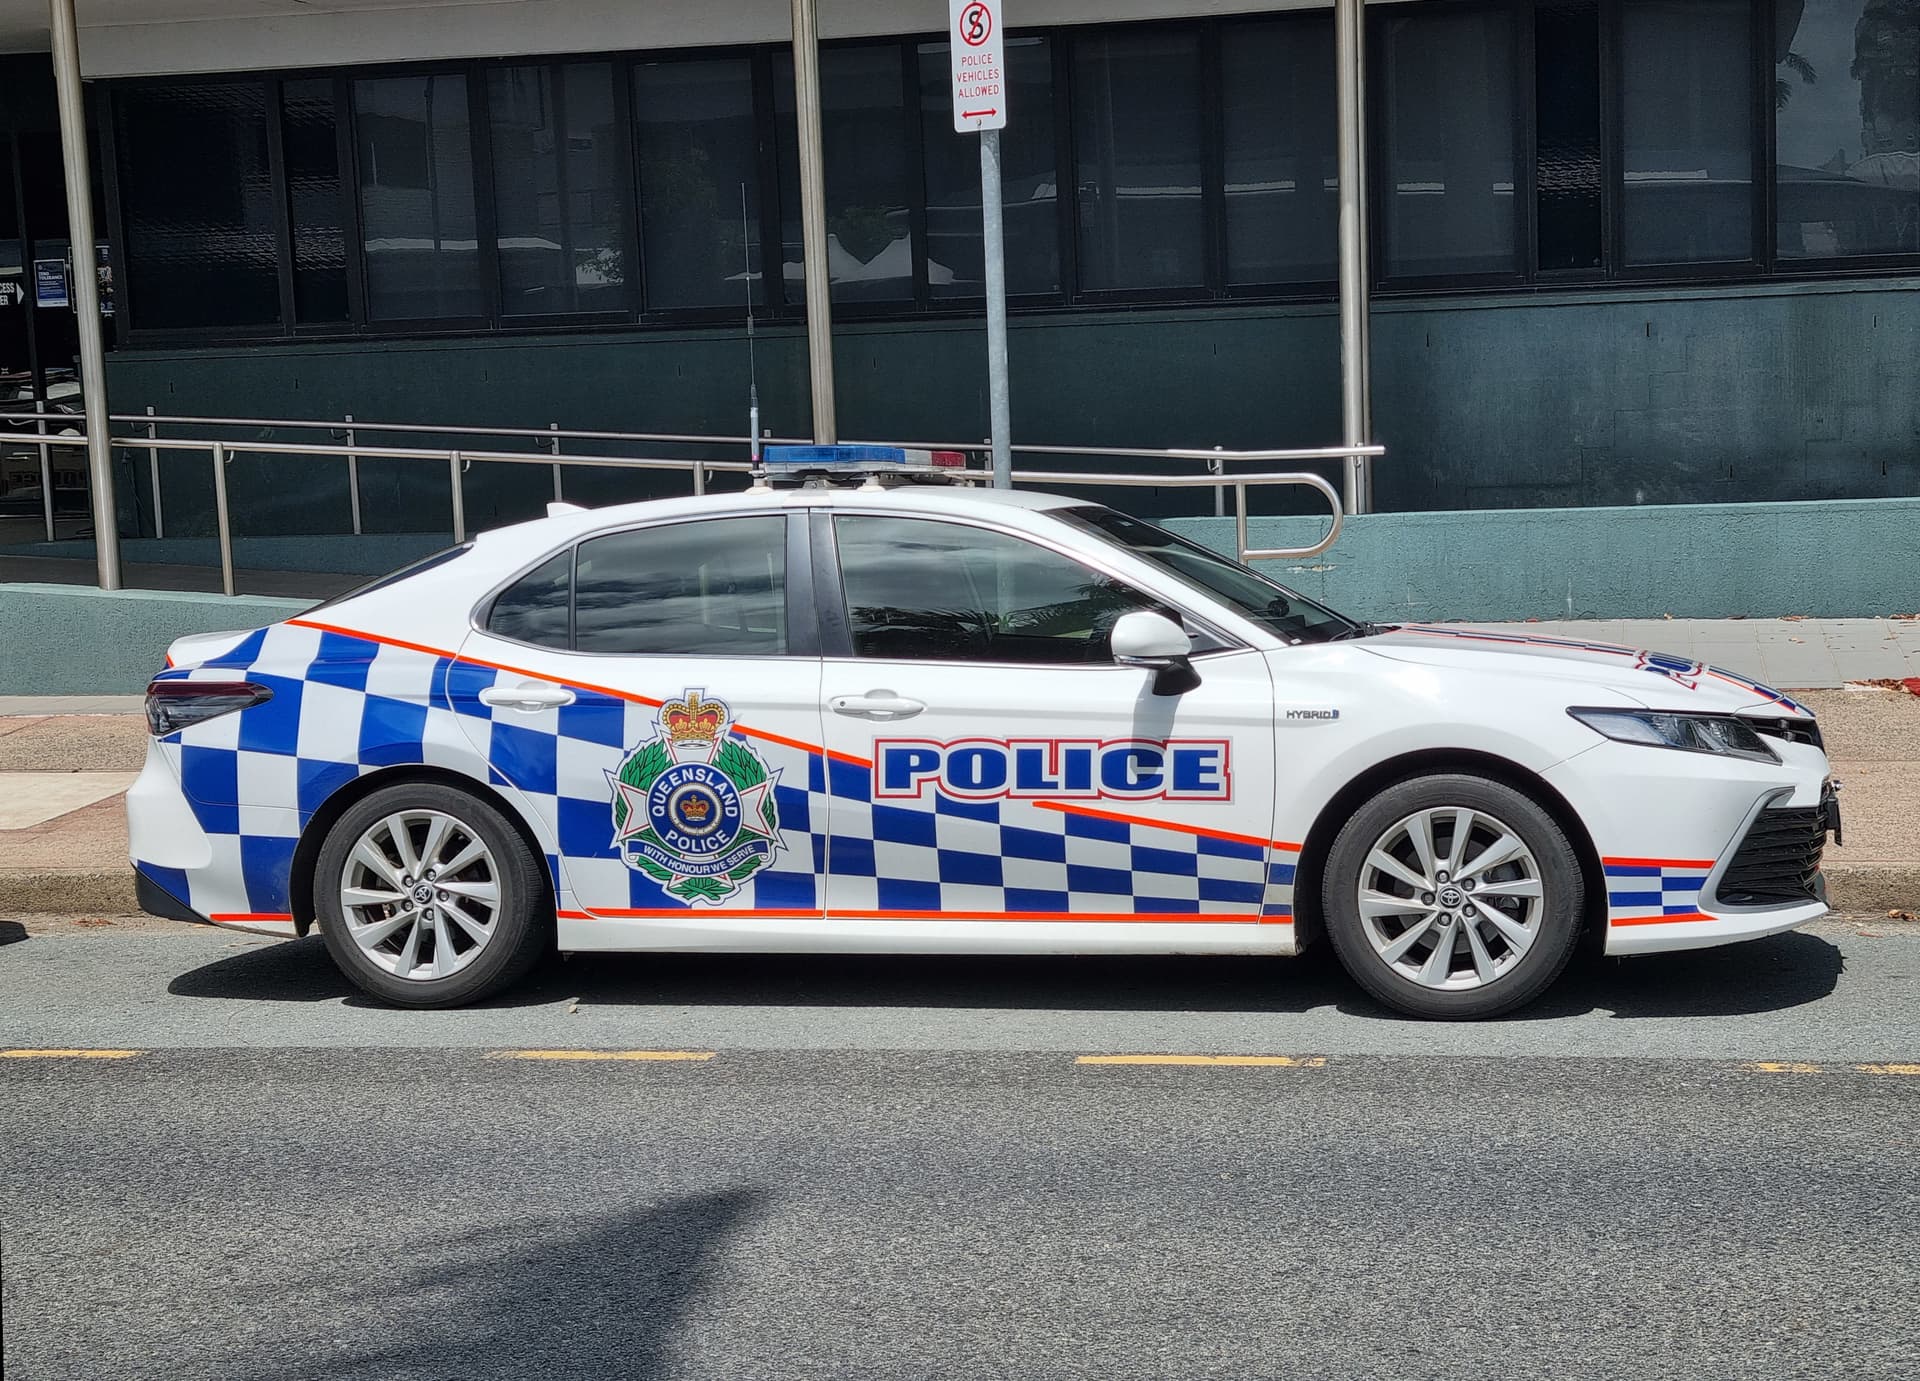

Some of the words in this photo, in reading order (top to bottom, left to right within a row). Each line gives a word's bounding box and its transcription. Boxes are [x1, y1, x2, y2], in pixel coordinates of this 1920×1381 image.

[961, 54, 993, 67] POLICE
[957, 68, 1000, 83] VEHICLES
[958, 85, 999, 98] ALLOWED
[1286, 709, 1332, 719] HYBRID
[882, 745, 1223, 793] POLICE
[652, 768, 738, 818] QUEENSLAND
[665, 829, 730, 853] POLICE
[643, 845, 666, 866] WITH
[669, 857, 710, 874] HONOUR
[711, 861, 728, 873] WE
[728, 845, 756, 868] SERVE
